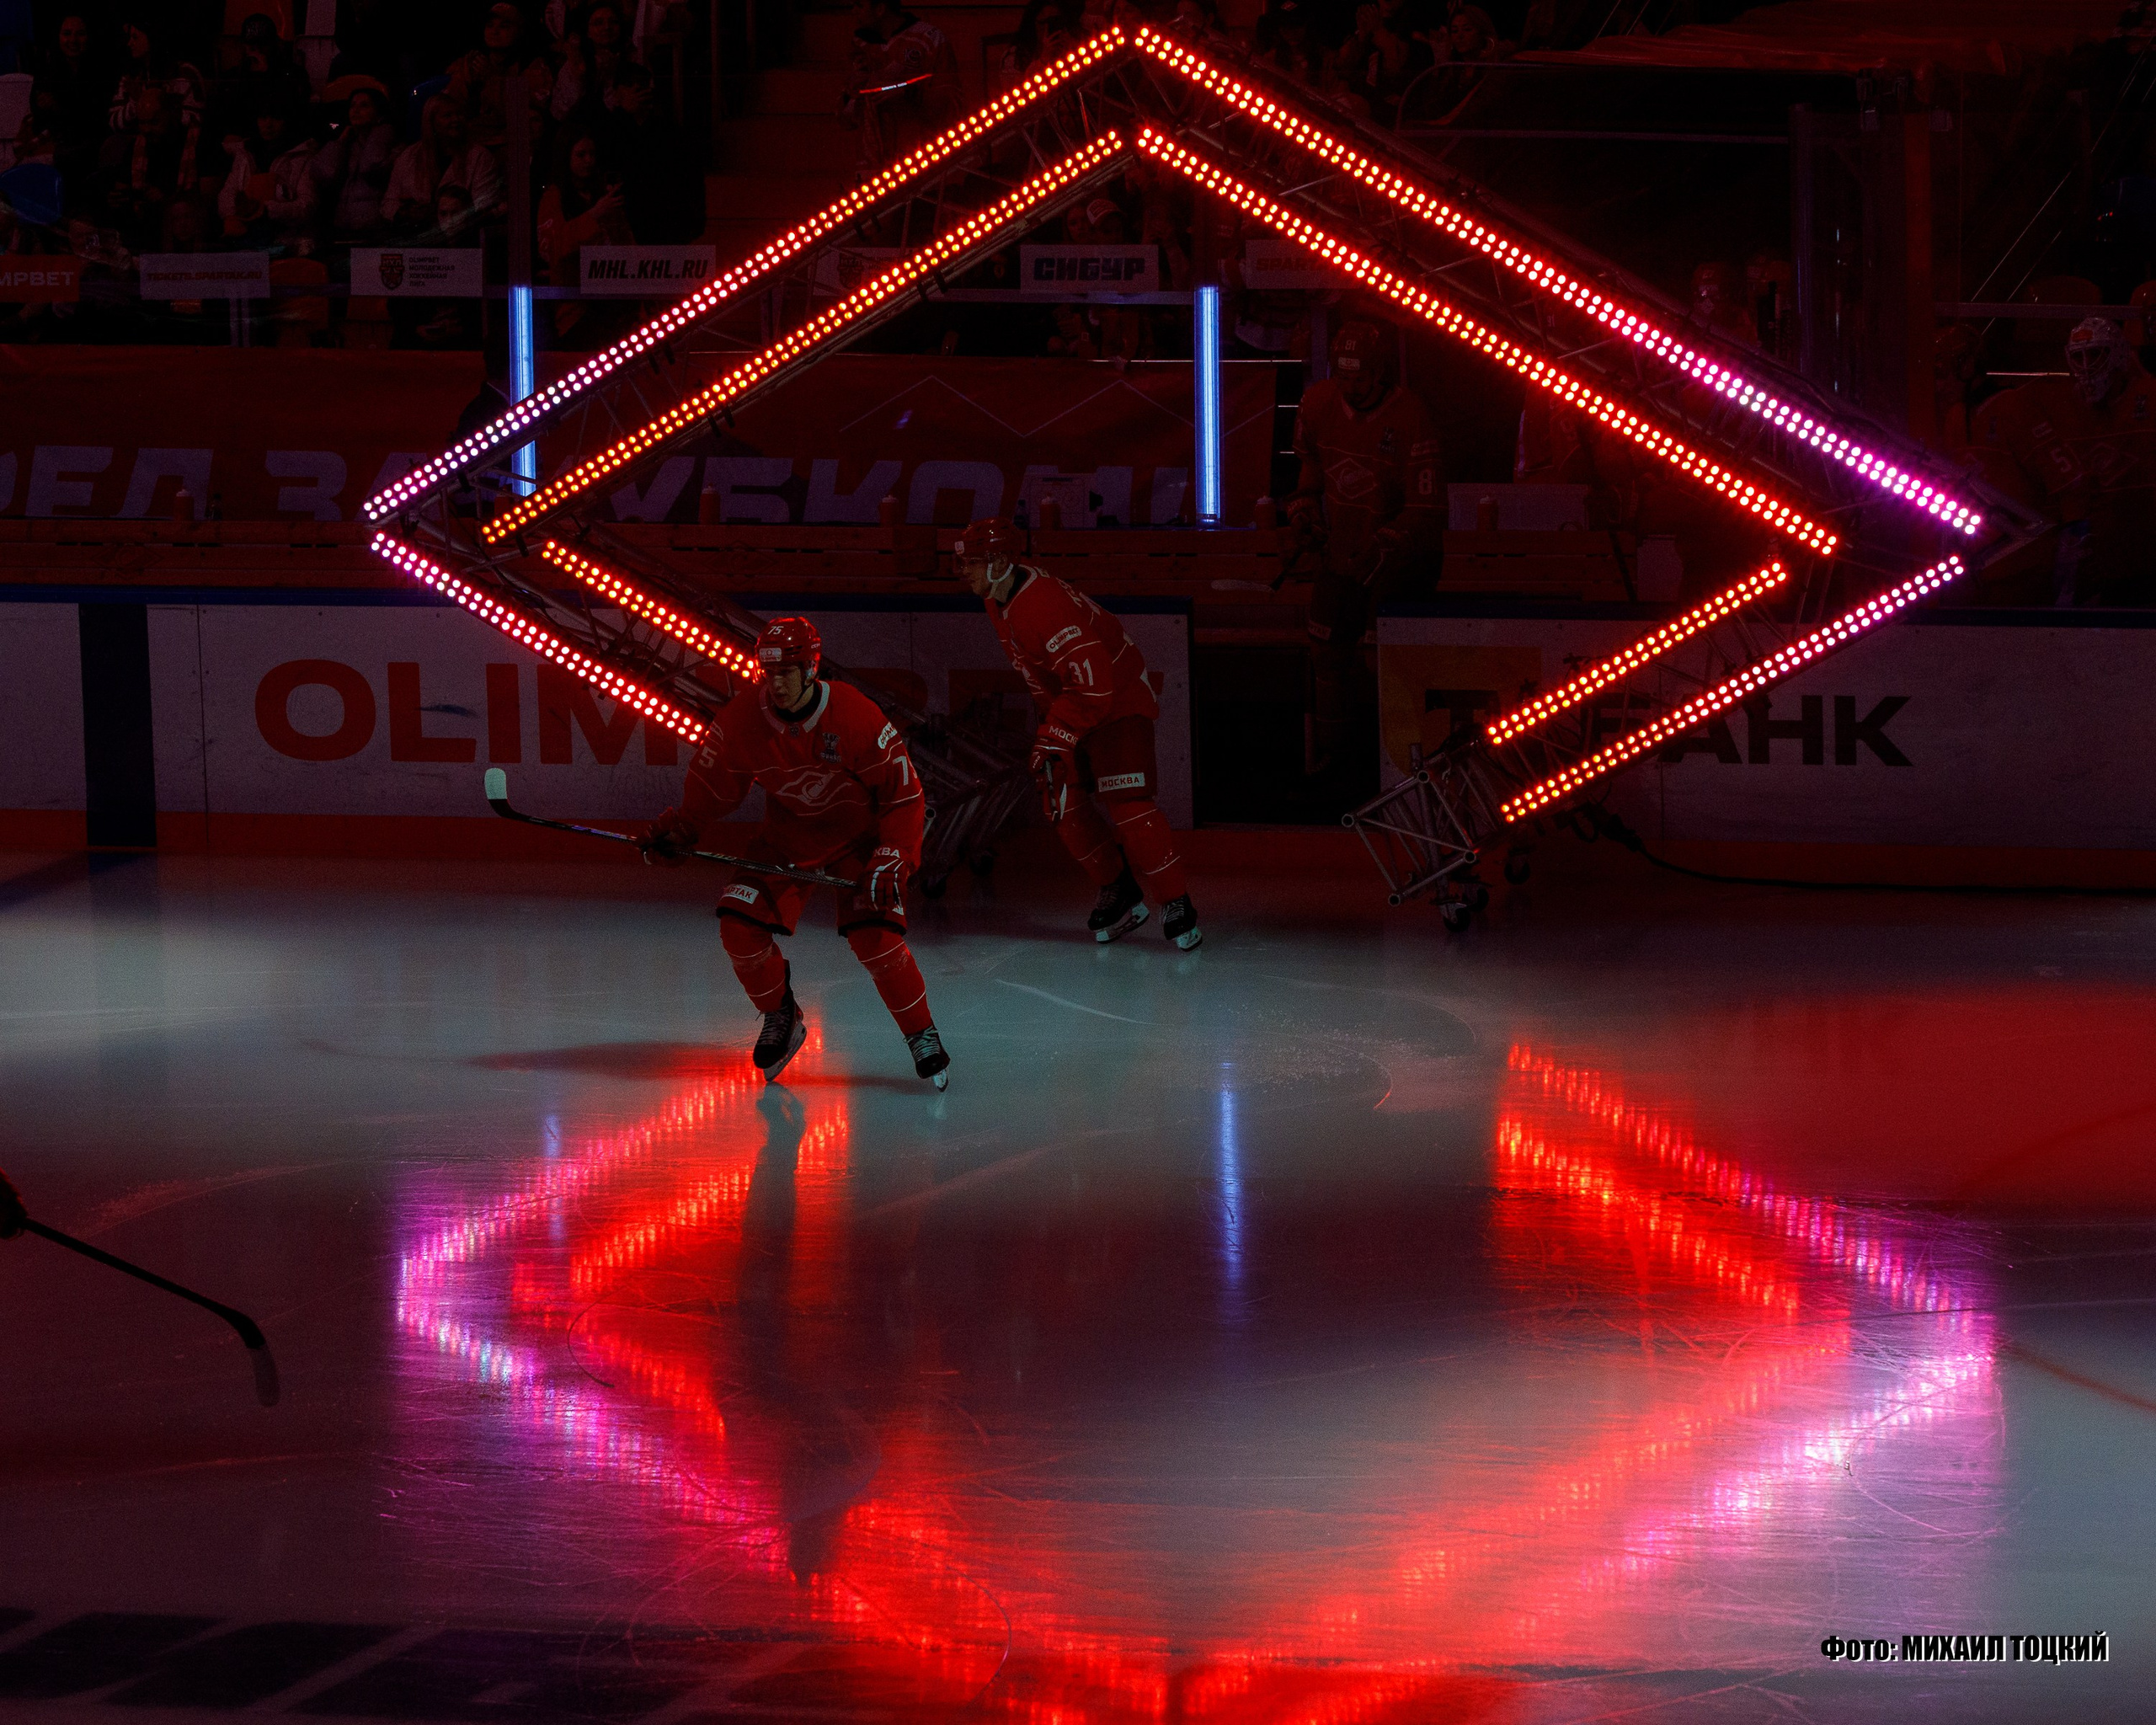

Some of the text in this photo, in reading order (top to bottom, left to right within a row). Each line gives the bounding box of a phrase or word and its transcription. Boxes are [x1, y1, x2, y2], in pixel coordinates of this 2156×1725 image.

[588, 259, 708, 280] MHL.KHL.RU
[767, 626, 784, 635] 75
[1049, 628, 1079, 649] OLIMPBET
[1069, 658, 1094, 686] 31
[1102, 777, 1140, 788] МОСКВА
